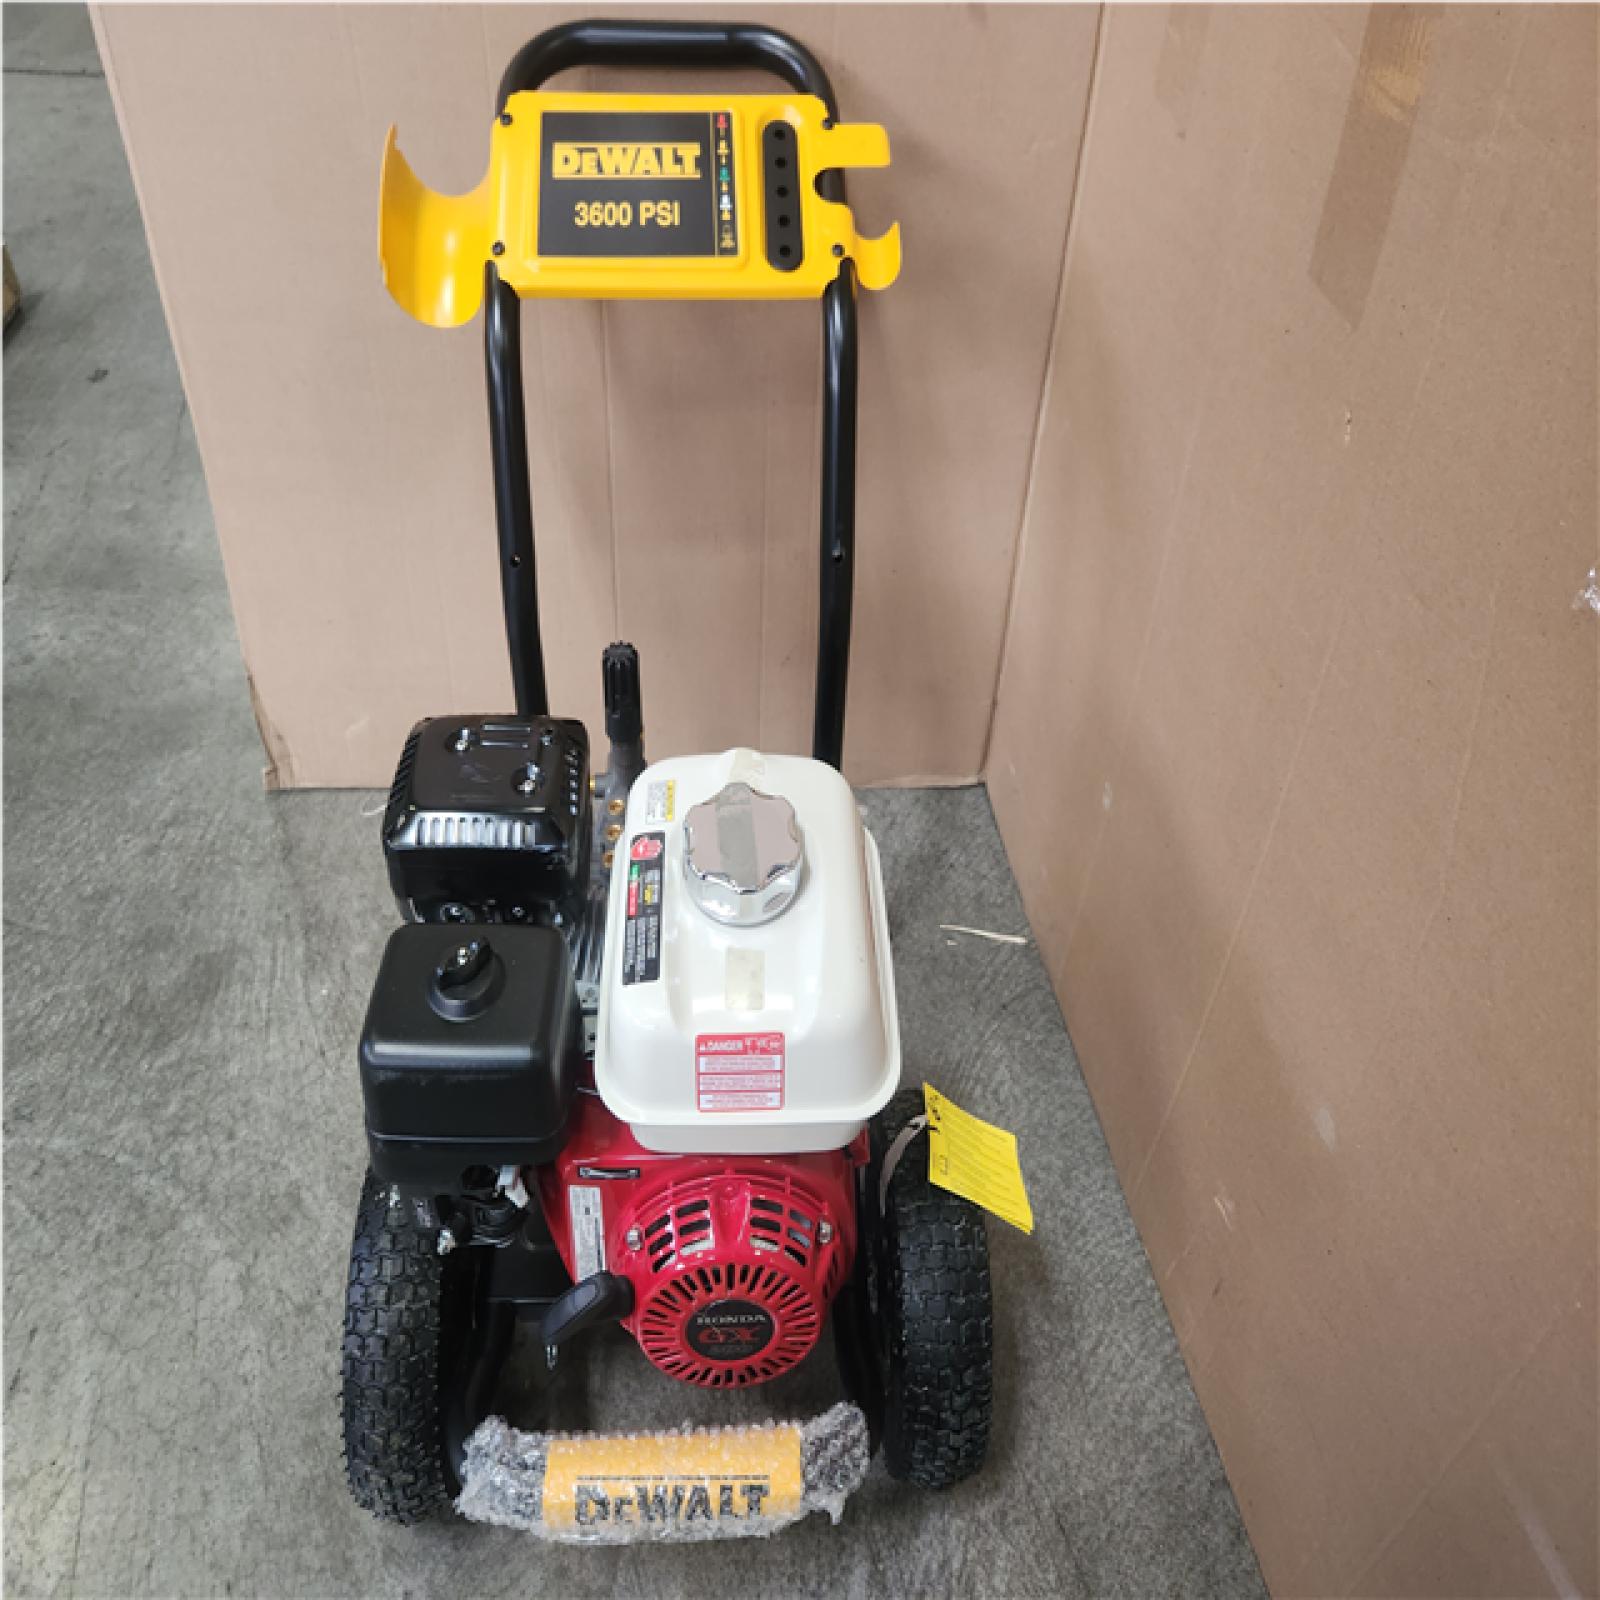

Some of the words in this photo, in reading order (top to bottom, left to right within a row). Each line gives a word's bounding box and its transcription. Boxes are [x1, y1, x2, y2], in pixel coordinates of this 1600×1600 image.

[574, 202, 632, 227] 3600
[639, 202, 680, 226] PSI
[696, 1314, 766, 1325] HONDA
